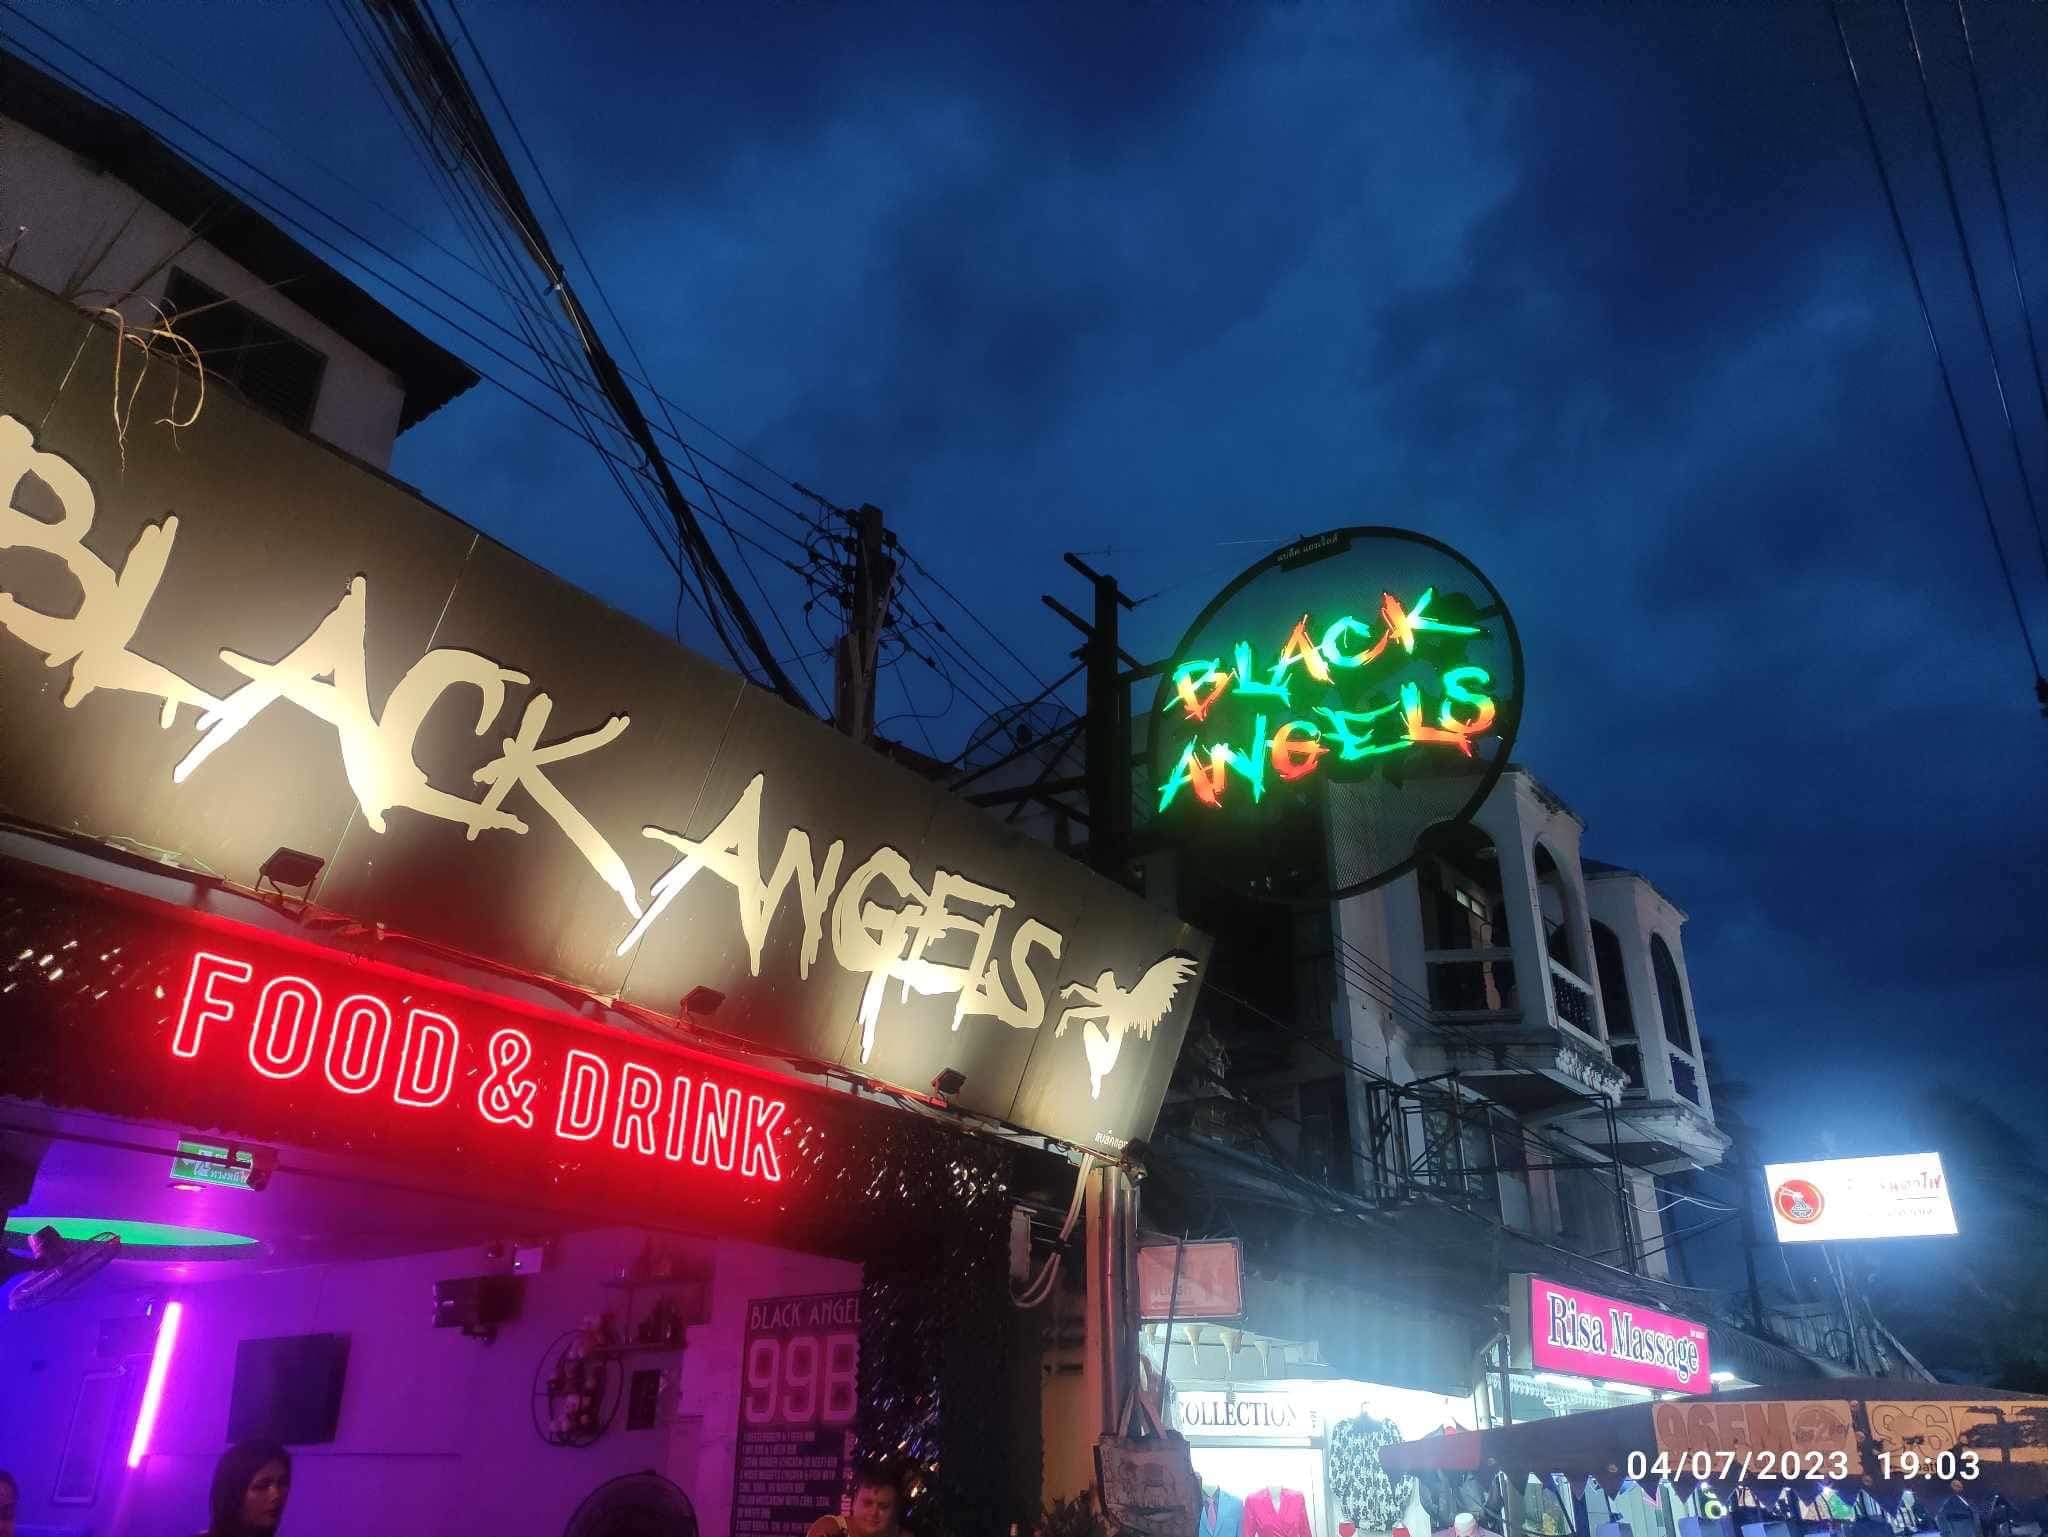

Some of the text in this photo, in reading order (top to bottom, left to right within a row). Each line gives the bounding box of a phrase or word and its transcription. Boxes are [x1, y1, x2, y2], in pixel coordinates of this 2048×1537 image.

[1163, 587, 1481, 722] BLACK
[0, 414, 1063, 1064] BLACK ANGELS
[1159, 667, 1496, 813] ANGELS
[172, 951, 786, 1182] FOOD & DRINK
[745, 1334, 860, 1424] 99B
[750, 1303, 801, 1330] BLACK
[1547, 1291, 1699, 1384] Risa Massage
